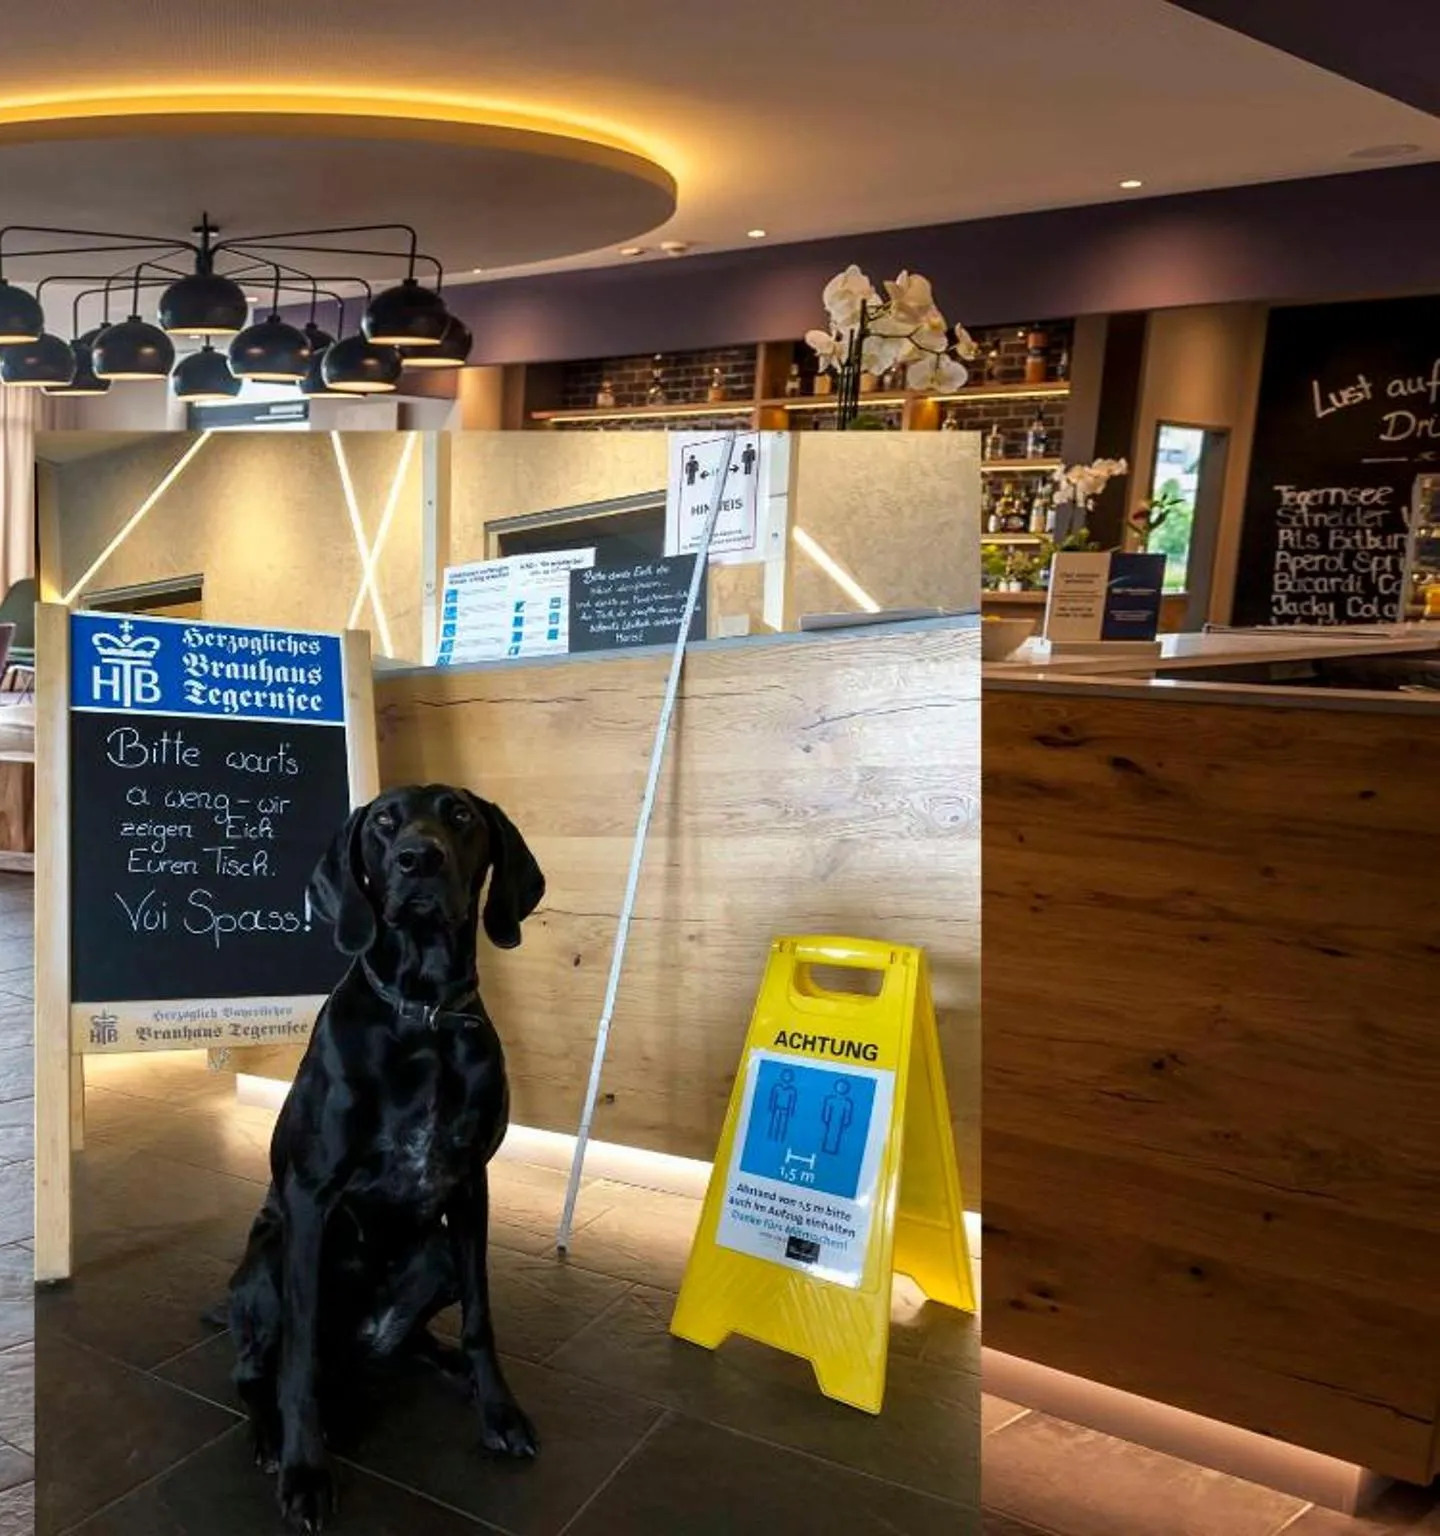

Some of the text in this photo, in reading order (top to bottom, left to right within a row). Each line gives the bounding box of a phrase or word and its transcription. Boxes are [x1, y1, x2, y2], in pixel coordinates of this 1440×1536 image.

[1312, 373, 1372, 418] Lust
[1379, 410, 1440, 441] Dri
[691, 499, 744, 516] HINEIS
[1329, 529, 1409, 551] Bitbur
[1275, 550, 1405, 584] Aperol Spri
[1273, 572, 1365, 594] Bacardi
[1270, 594, 1335, 620] Jacky
[182, 627, 321, 656] Herzogliches
[182, 653, 323, 686] Brauhaus
[106, 726, 201, 769] Bitte
[126, 787, 150, 805] a
[120, 820, 194, 853] zeigen
[128, 848, 199, 875] Euren
[184, 886, 312, 949] Spass!
[136, 1023, 223, 1043] Brauhaus
[773, 1030, 879, 1062] ACHTUNG
[779, 1166, 797, 1182] 1,5
[736, 1183, 777, 1201] Abstand
